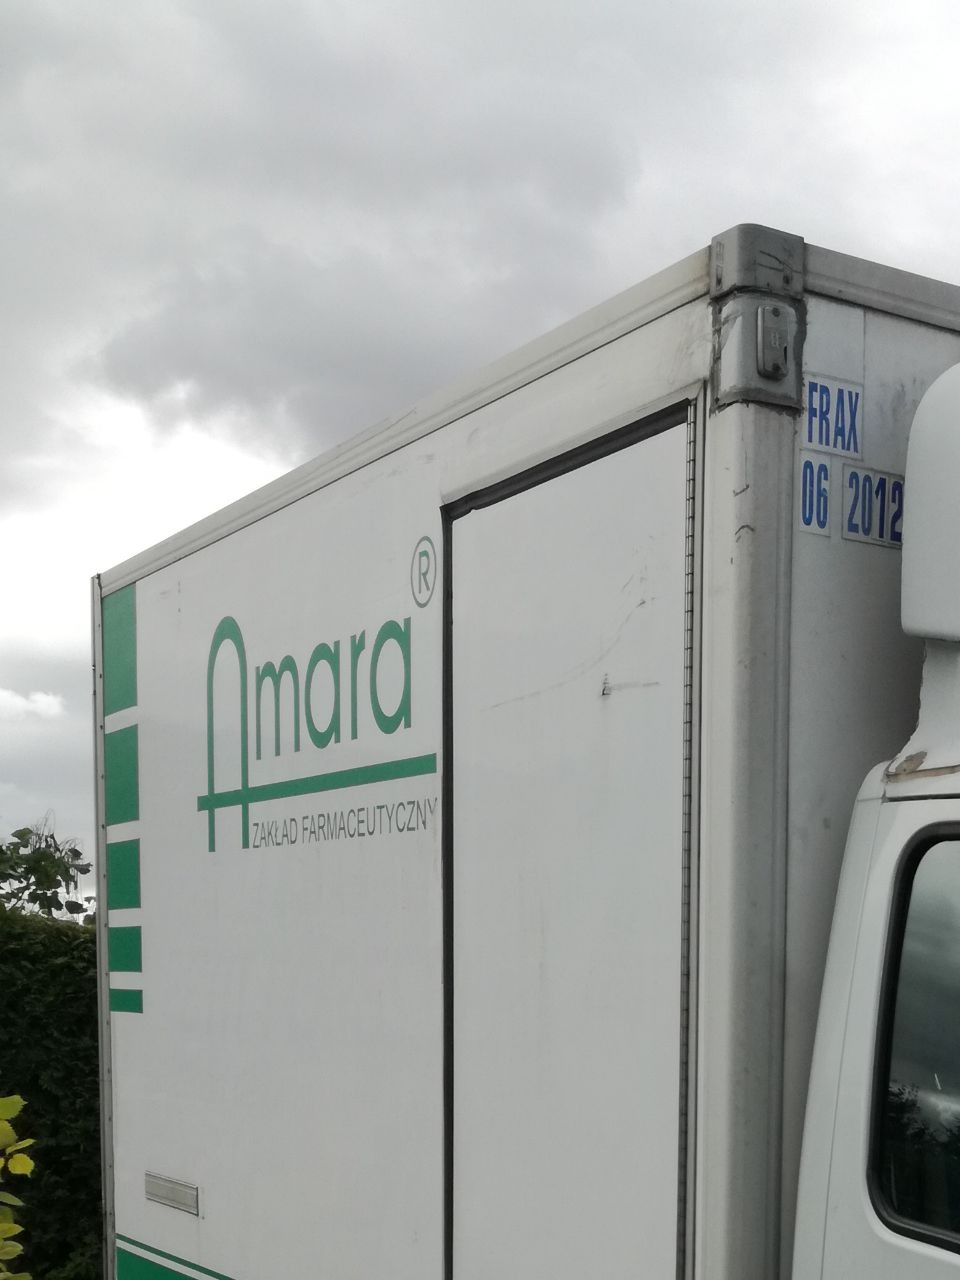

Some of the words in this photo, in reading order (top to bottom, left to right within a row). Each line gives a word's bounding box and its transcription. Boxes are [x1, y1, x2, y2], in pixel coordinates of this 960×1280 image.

[807, 381, 859, 453] FRAX
[801, 460, 829, 529] 06
[847, 470, 903, 543] 2012
[206, 615, 412, 852] Amara
[252, 817, 299, 849] ZAKŁAD
[302, 797, 438, 844] FARMACEUTYCZNY
